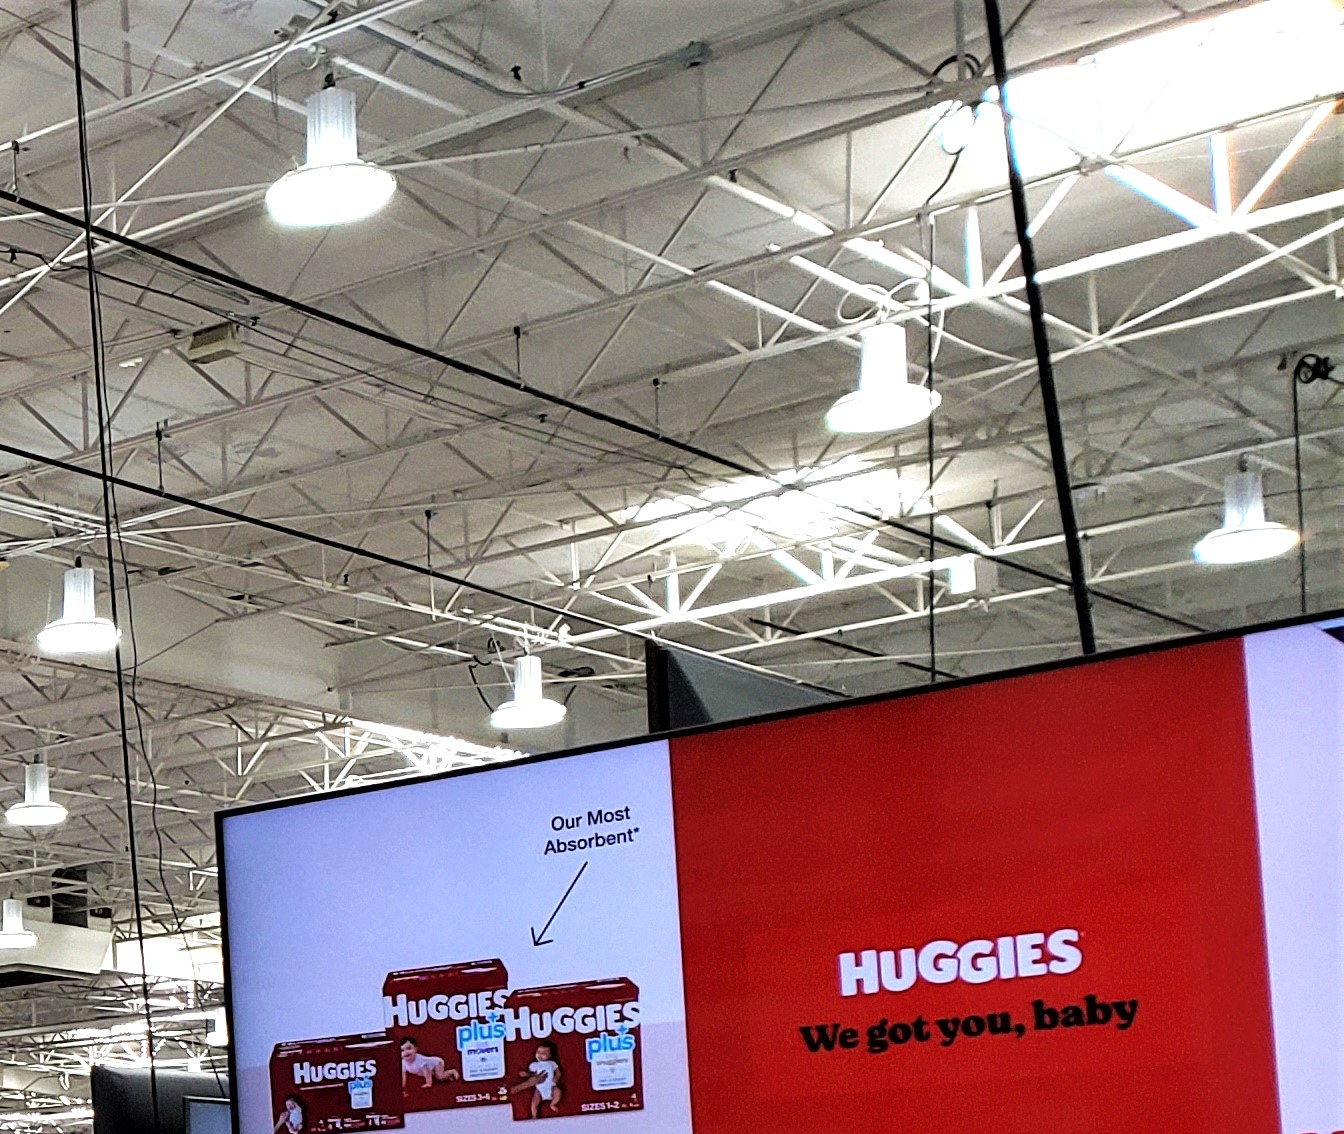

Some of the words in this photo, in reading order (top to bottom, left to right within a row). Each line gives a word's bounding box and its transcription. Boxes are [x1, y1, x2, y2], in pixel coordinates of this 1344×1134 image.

[551, 815, 582, 831] Our
[587, 805, 631, 826] Most
[838, 929, 1083, 997] HUGGIES
[382, 988, 511, 1028] HUGGIES
[506, 1001, 643, 1042] HUGGIES
[799, 1024, 860, 1052] We
[866, 1015, 932, 1054] got
[936, 1011, 1025, 1047] you,
[1031, 994, 1138, 1031] baby
[585, 1031, 635, 1061] plus
[293, 1060, 377, 1085] HUGGIES
